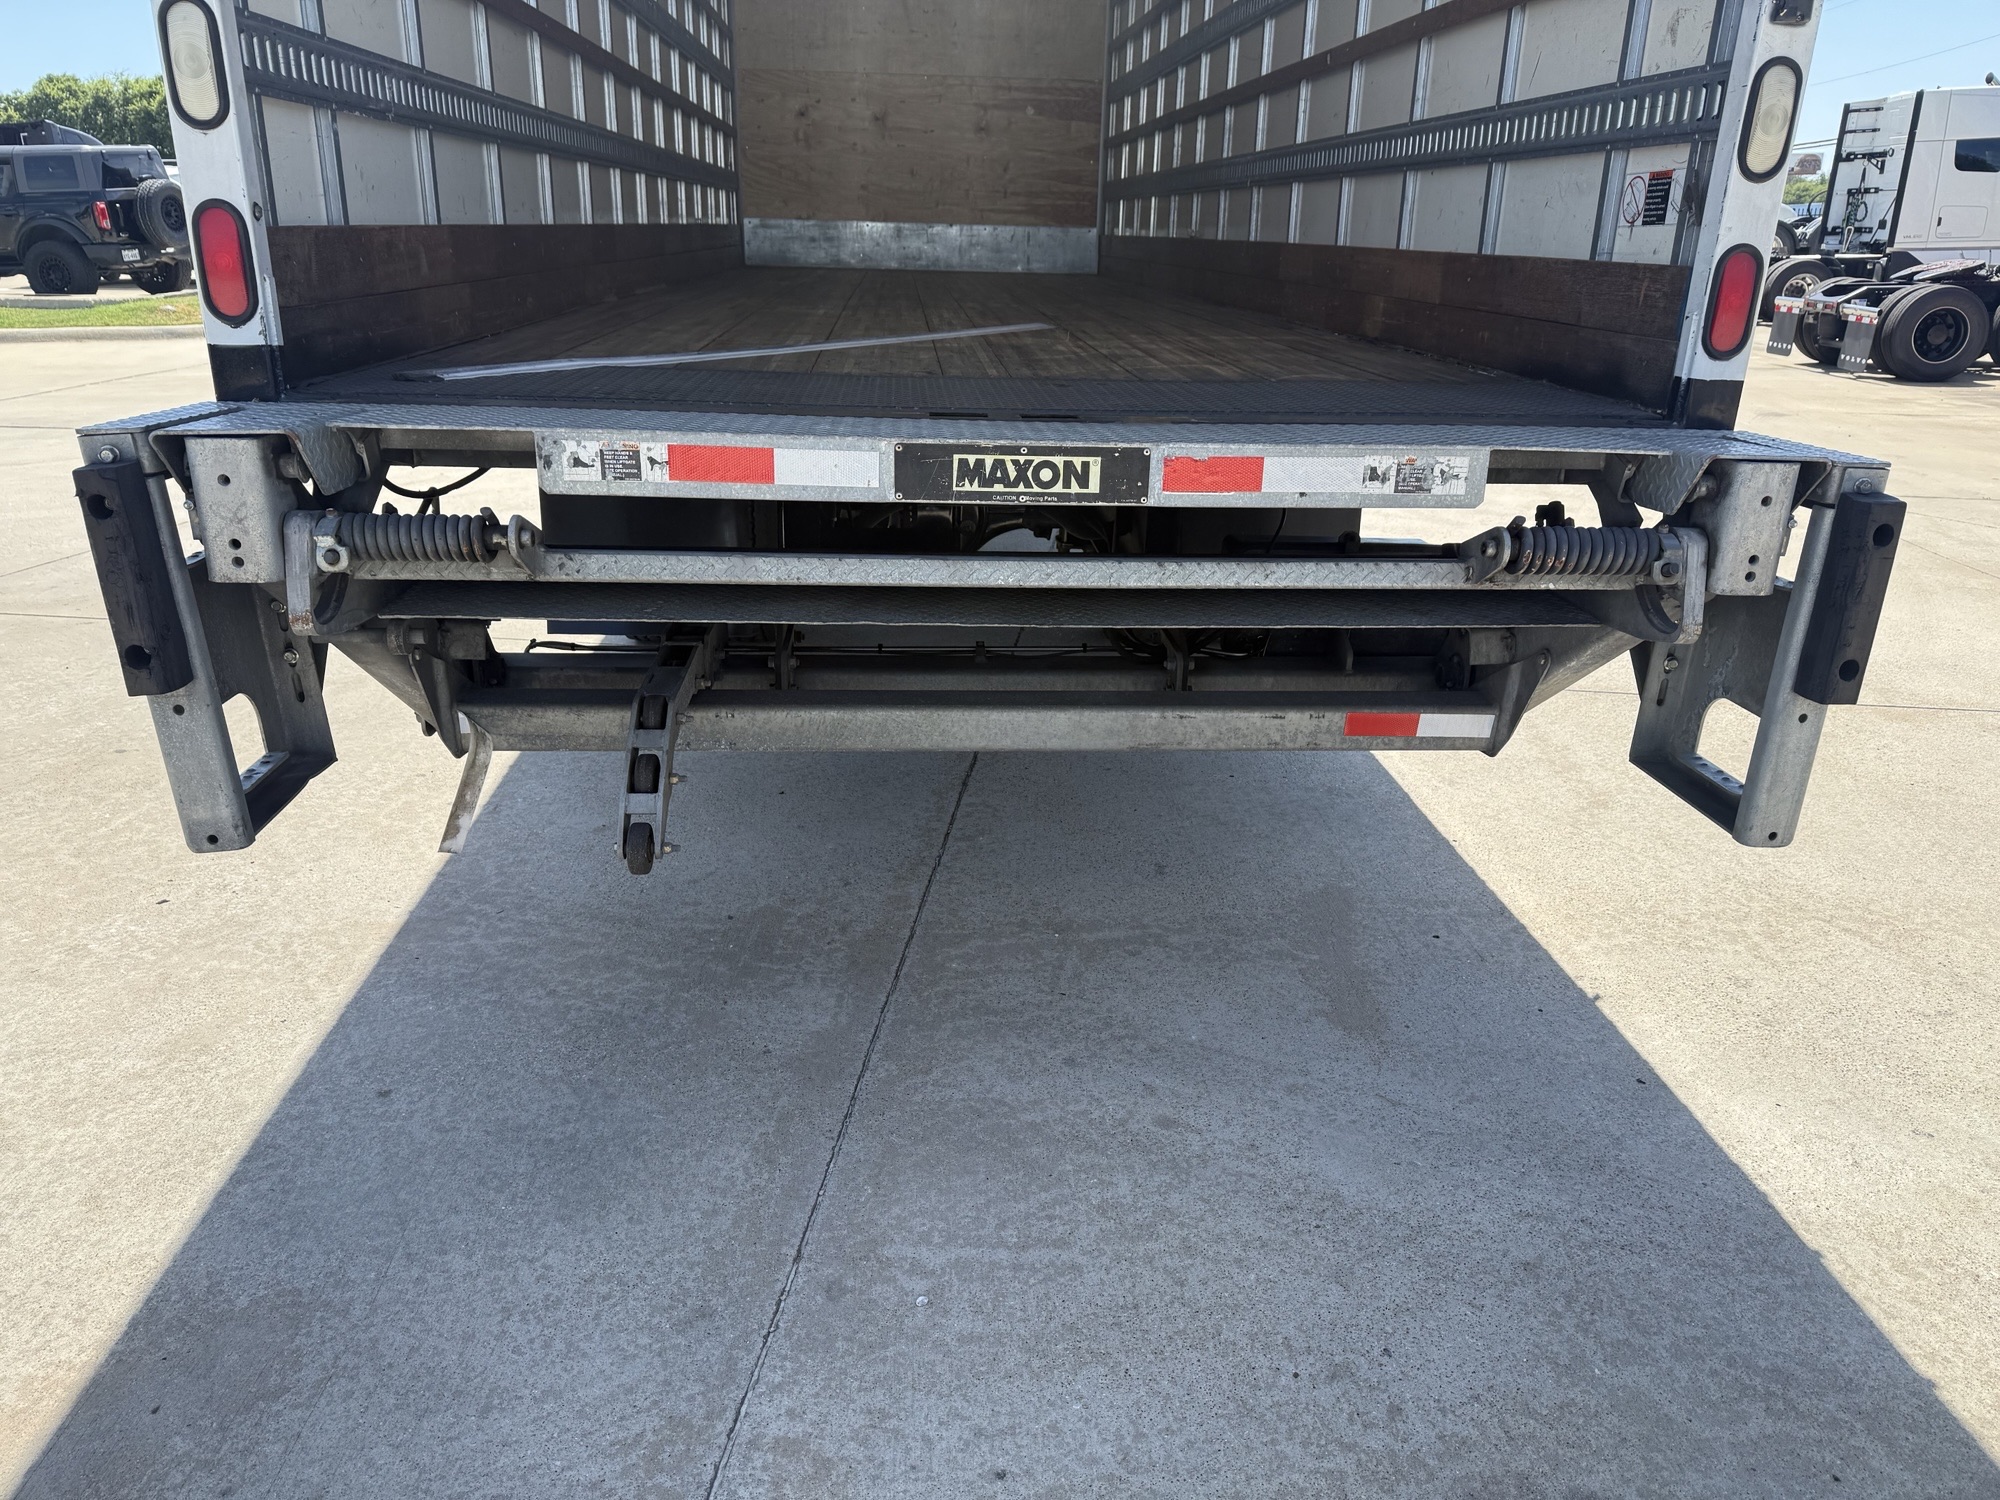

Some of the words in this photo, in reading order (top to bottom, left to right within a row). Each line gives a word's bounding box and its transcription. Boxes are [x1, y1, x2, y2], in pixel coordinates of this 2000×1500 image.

[1769, 341, 1791, 349] VOLVO
[1840, 354, 1866, 364] VOLVO
[955, 458, 1090, 490] MAXON
